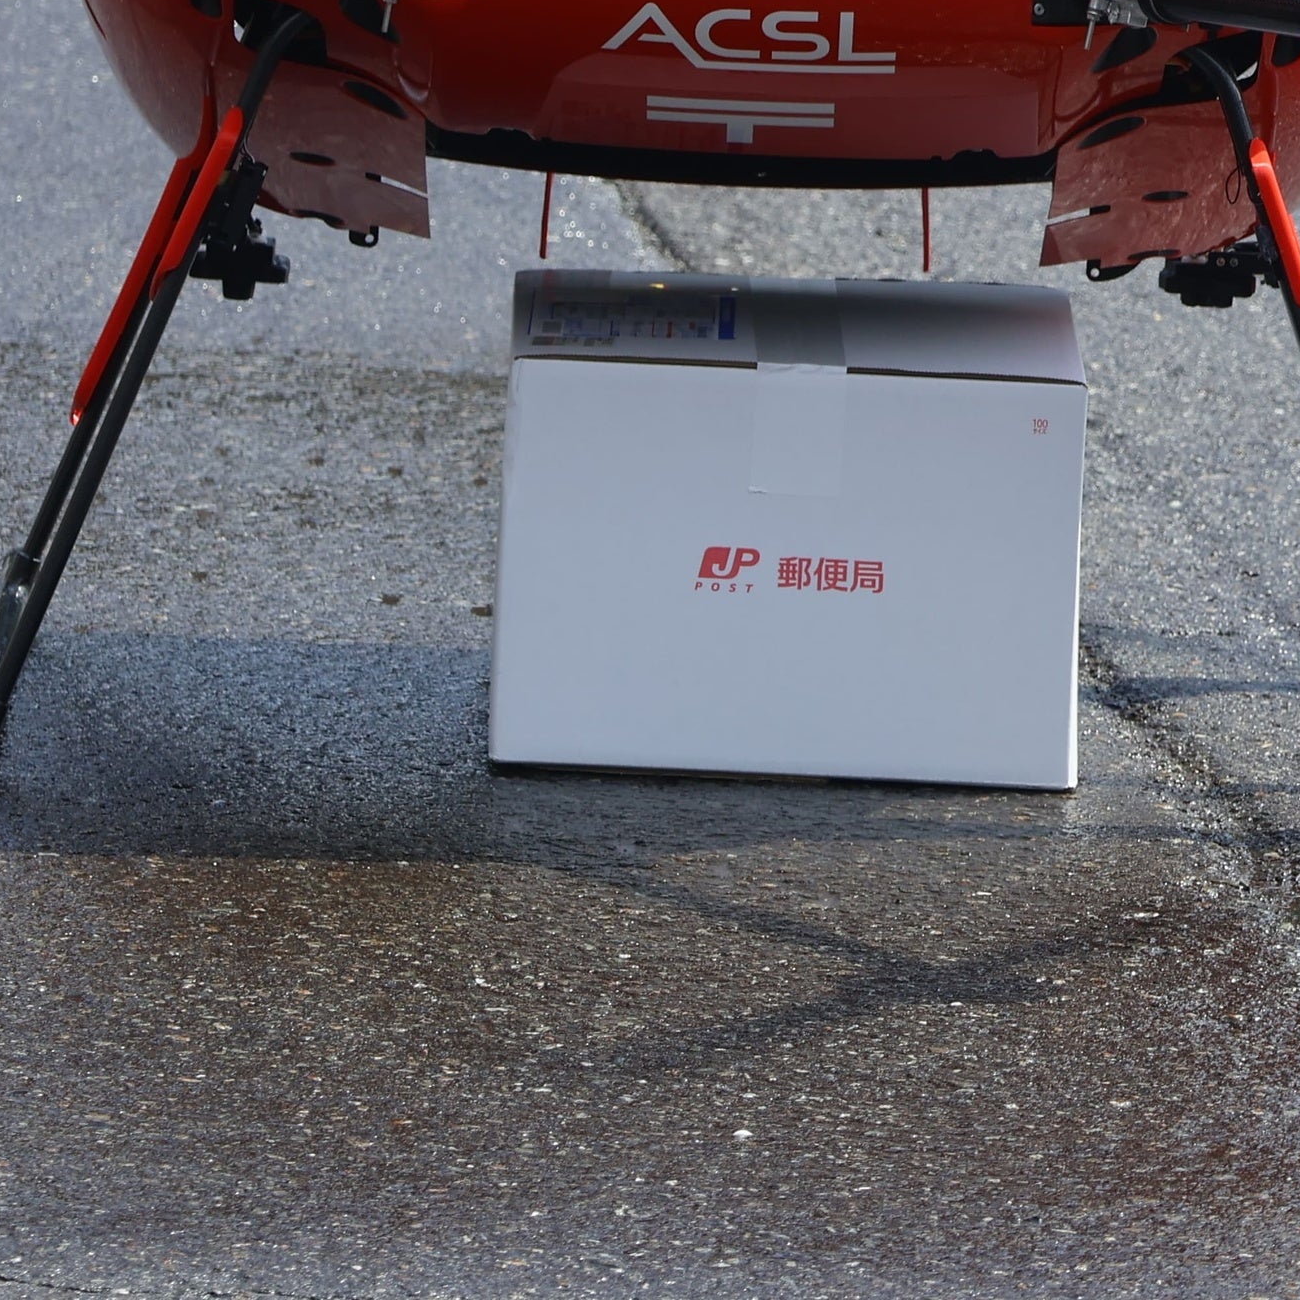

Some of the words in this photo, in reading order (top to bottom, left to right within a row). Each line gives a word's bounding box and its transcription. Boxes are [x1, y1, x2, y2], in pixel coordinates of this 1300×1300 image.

[601, 2, 897, 73] ACSL
[1032, 418, 1049, 429] 100
[694, 581, 754, 594] POST
[777, 556, 885, 594] 郵便局
